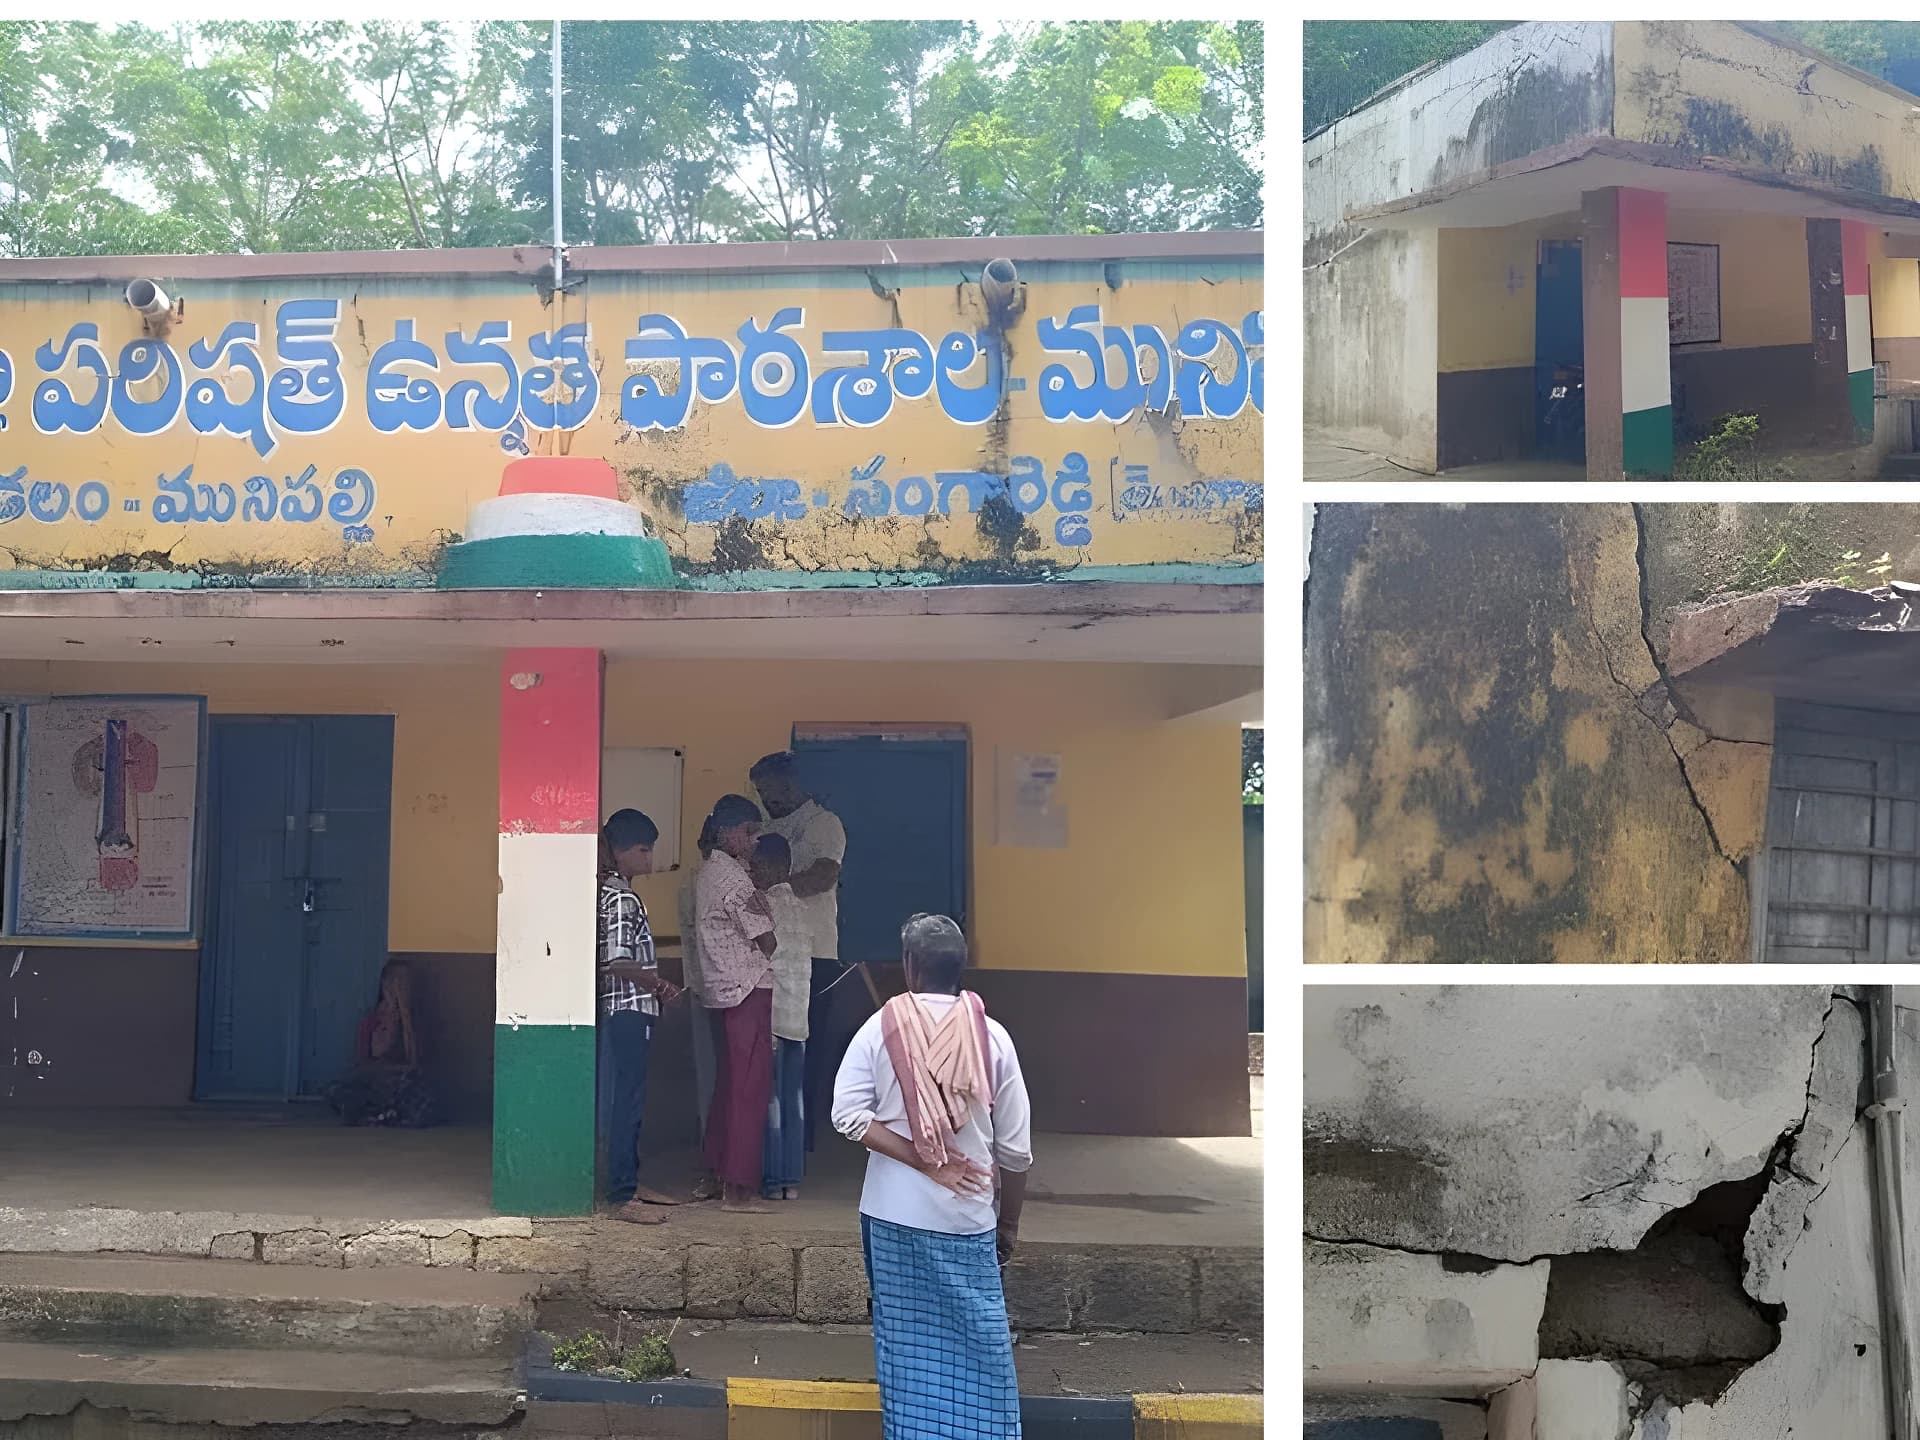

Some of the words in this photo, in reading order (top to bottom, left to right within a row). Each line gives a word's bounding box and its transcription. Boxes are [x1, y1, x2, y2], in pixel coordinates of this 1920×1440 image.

[31, 299, 348, 464] పరిషత్
[366, 317, 601, 458] ఉన్నత
[620, 306, 1006, 431] పాఠశాల
